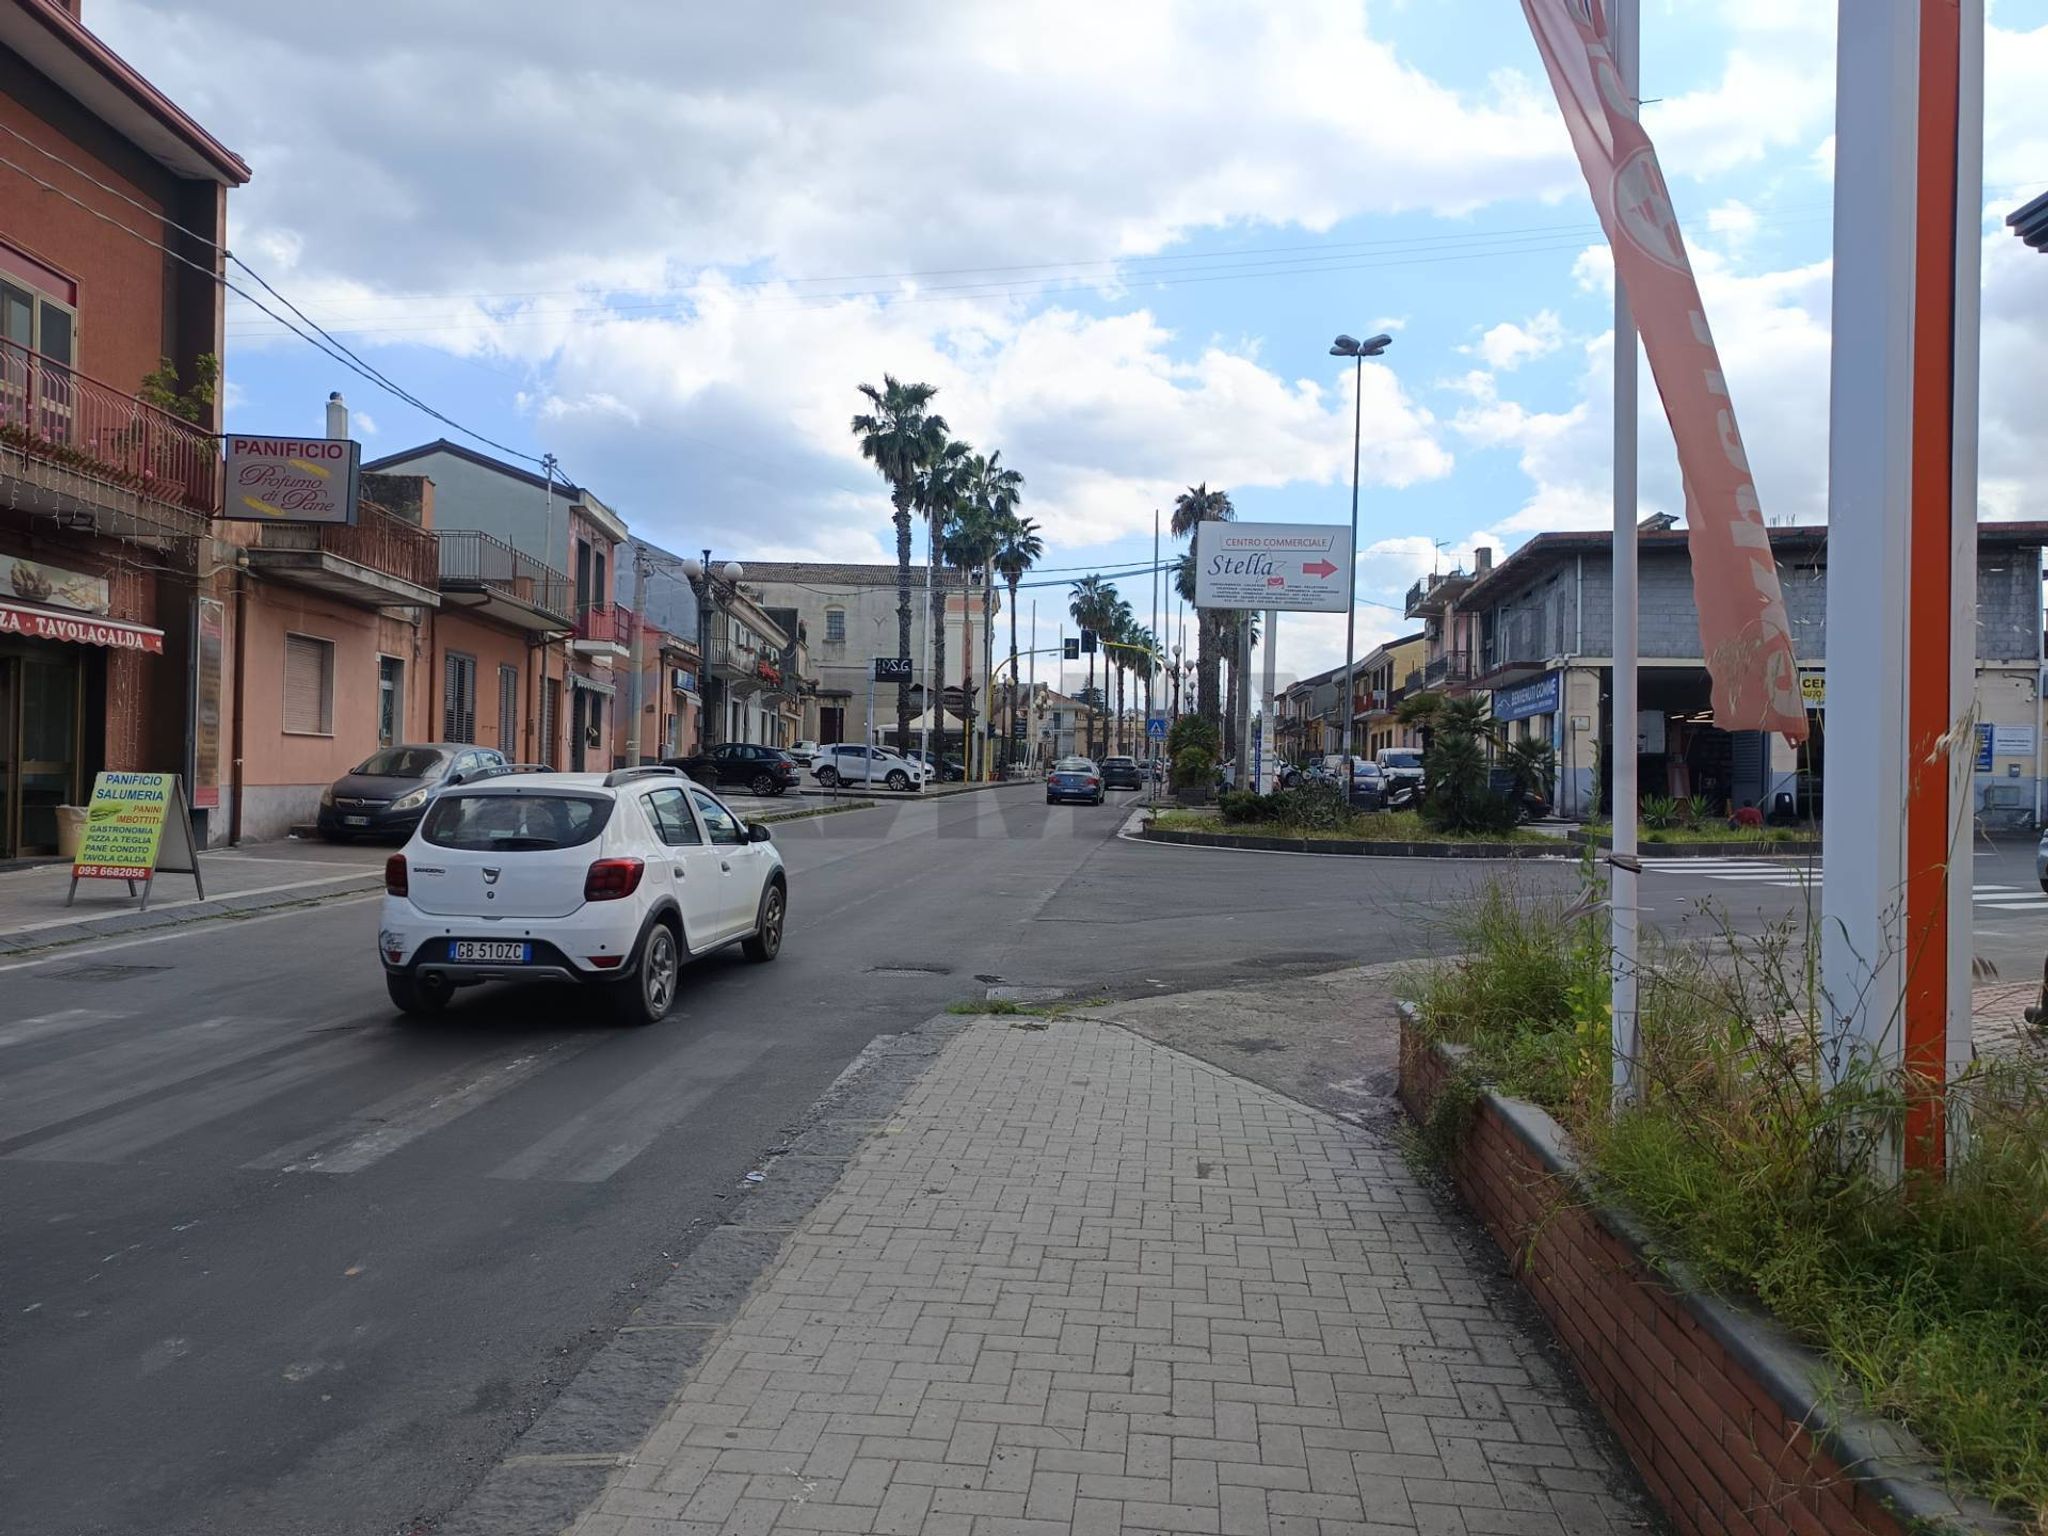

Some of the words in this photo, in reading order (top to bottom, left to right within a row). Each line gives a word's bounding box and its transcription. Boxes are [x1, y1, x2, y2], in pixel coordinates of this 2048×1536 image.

[235, 440, 343, 459] PANIFICIO
[239, 464, 322, 491] Profumo
[261, 490, 280, 501] di
[281, 488, 335, 511] Pane
[1225, 538, 1262, 547] CENTRO
[1263, 538, 1327, 548] COMMERCIALE
[1207, 553, 1273, 576] Stella
[36, 617, 144, 648] TAVOLACALDA
[105, 774, 162, 786] PANIFICIO
[96, 788, 164, 801] SALUMERIA
[133, 805, 162, 813] PANINI
[116, 815, 160, 825] IMBOTTITI
[89, 825, 153, 834] GASTRONOMIA
[121, 836, 151, 844] TEGLIA
[84, 844, 107, 852] PANE
[109, 845, 149, 854] CONDITO
[83, 854, 115, 862] TAVOLA
[116, 854, 147, 863] CALDA
[78, 866, 99, 875] 095
[99, 867, 145, 877] 6682056
[457, 943, 474, 958] GB
[479, 943, 522, 960] 510ZC
